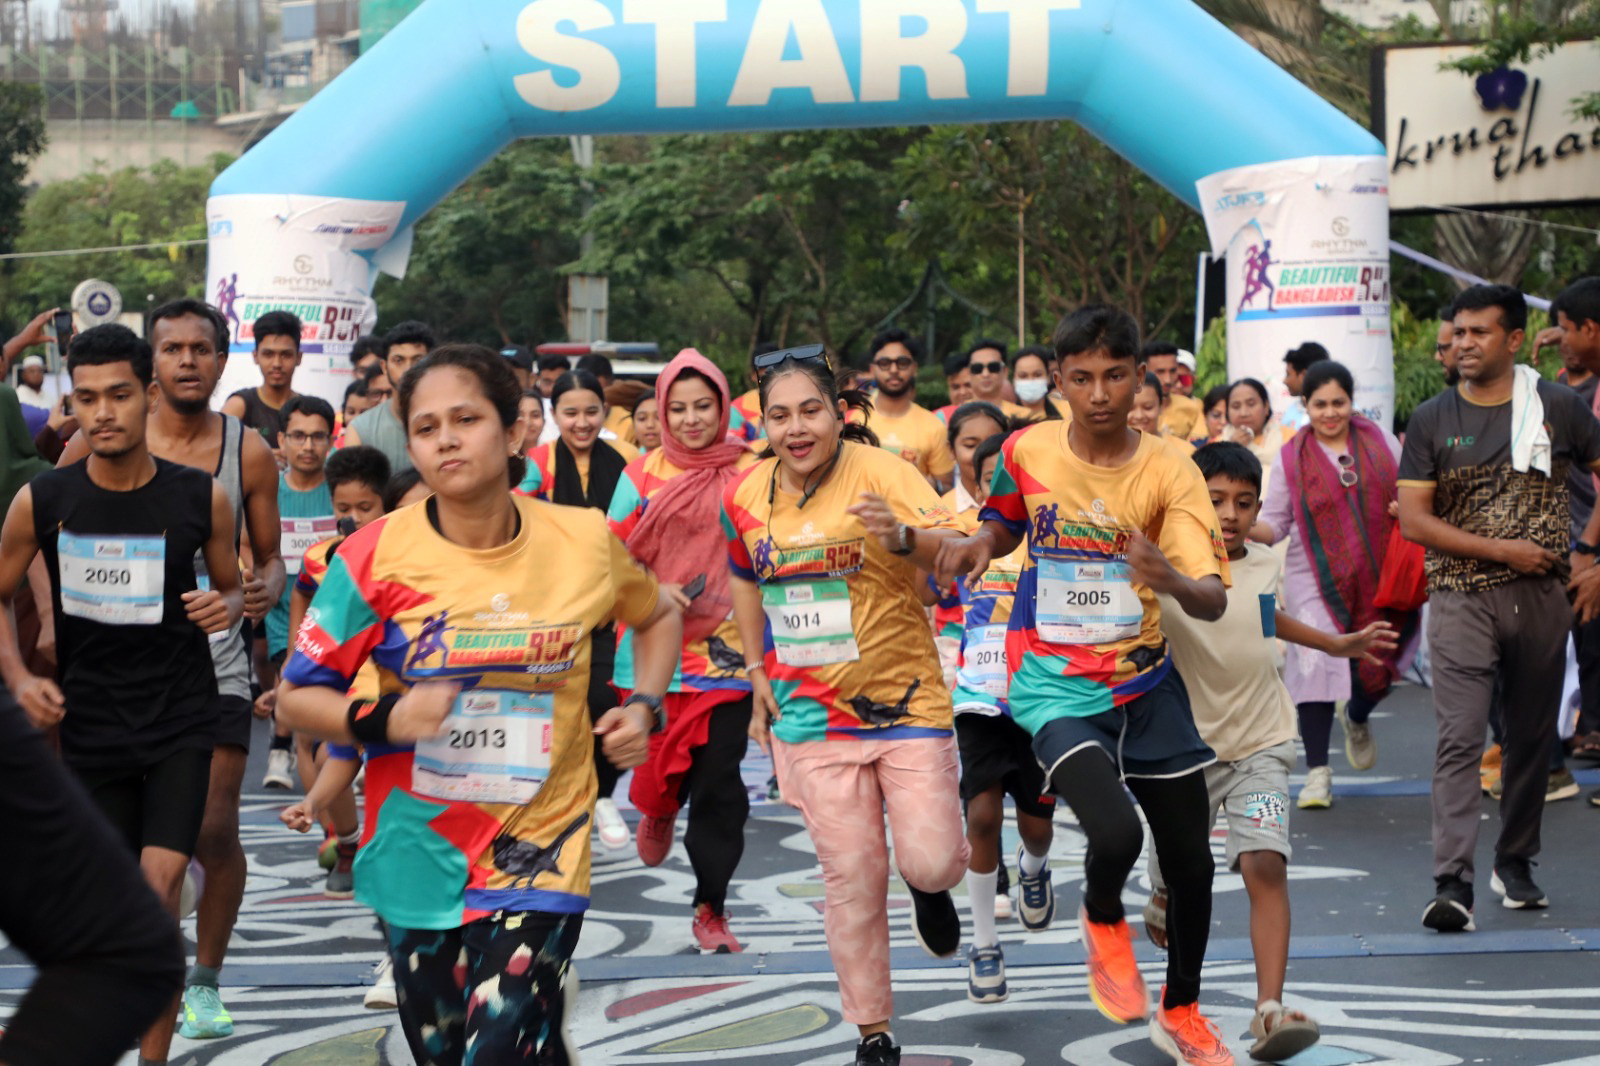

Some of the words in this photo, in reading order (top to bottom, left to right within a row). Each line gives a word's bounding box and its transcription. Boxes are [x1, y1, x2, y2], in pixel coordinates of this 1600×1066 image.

[513, 0, 1081, 112] START
[1391, 117, 1517, 174] krua
[1279, 266, 1359, 286] BEAUTIFUL
[1275, 287, 1355, 305] BANGLADESH
[1062, 523, 1114, 542] BEAUTIFUL
[824, 544, 862, 572] RUN
[85, 567, 131, 585] 2050
[1066, 590, 1111, 606] 2005
[453, 632, 528, 649] BEAUTIFUL
[449, 728, 506, 749] 2013
